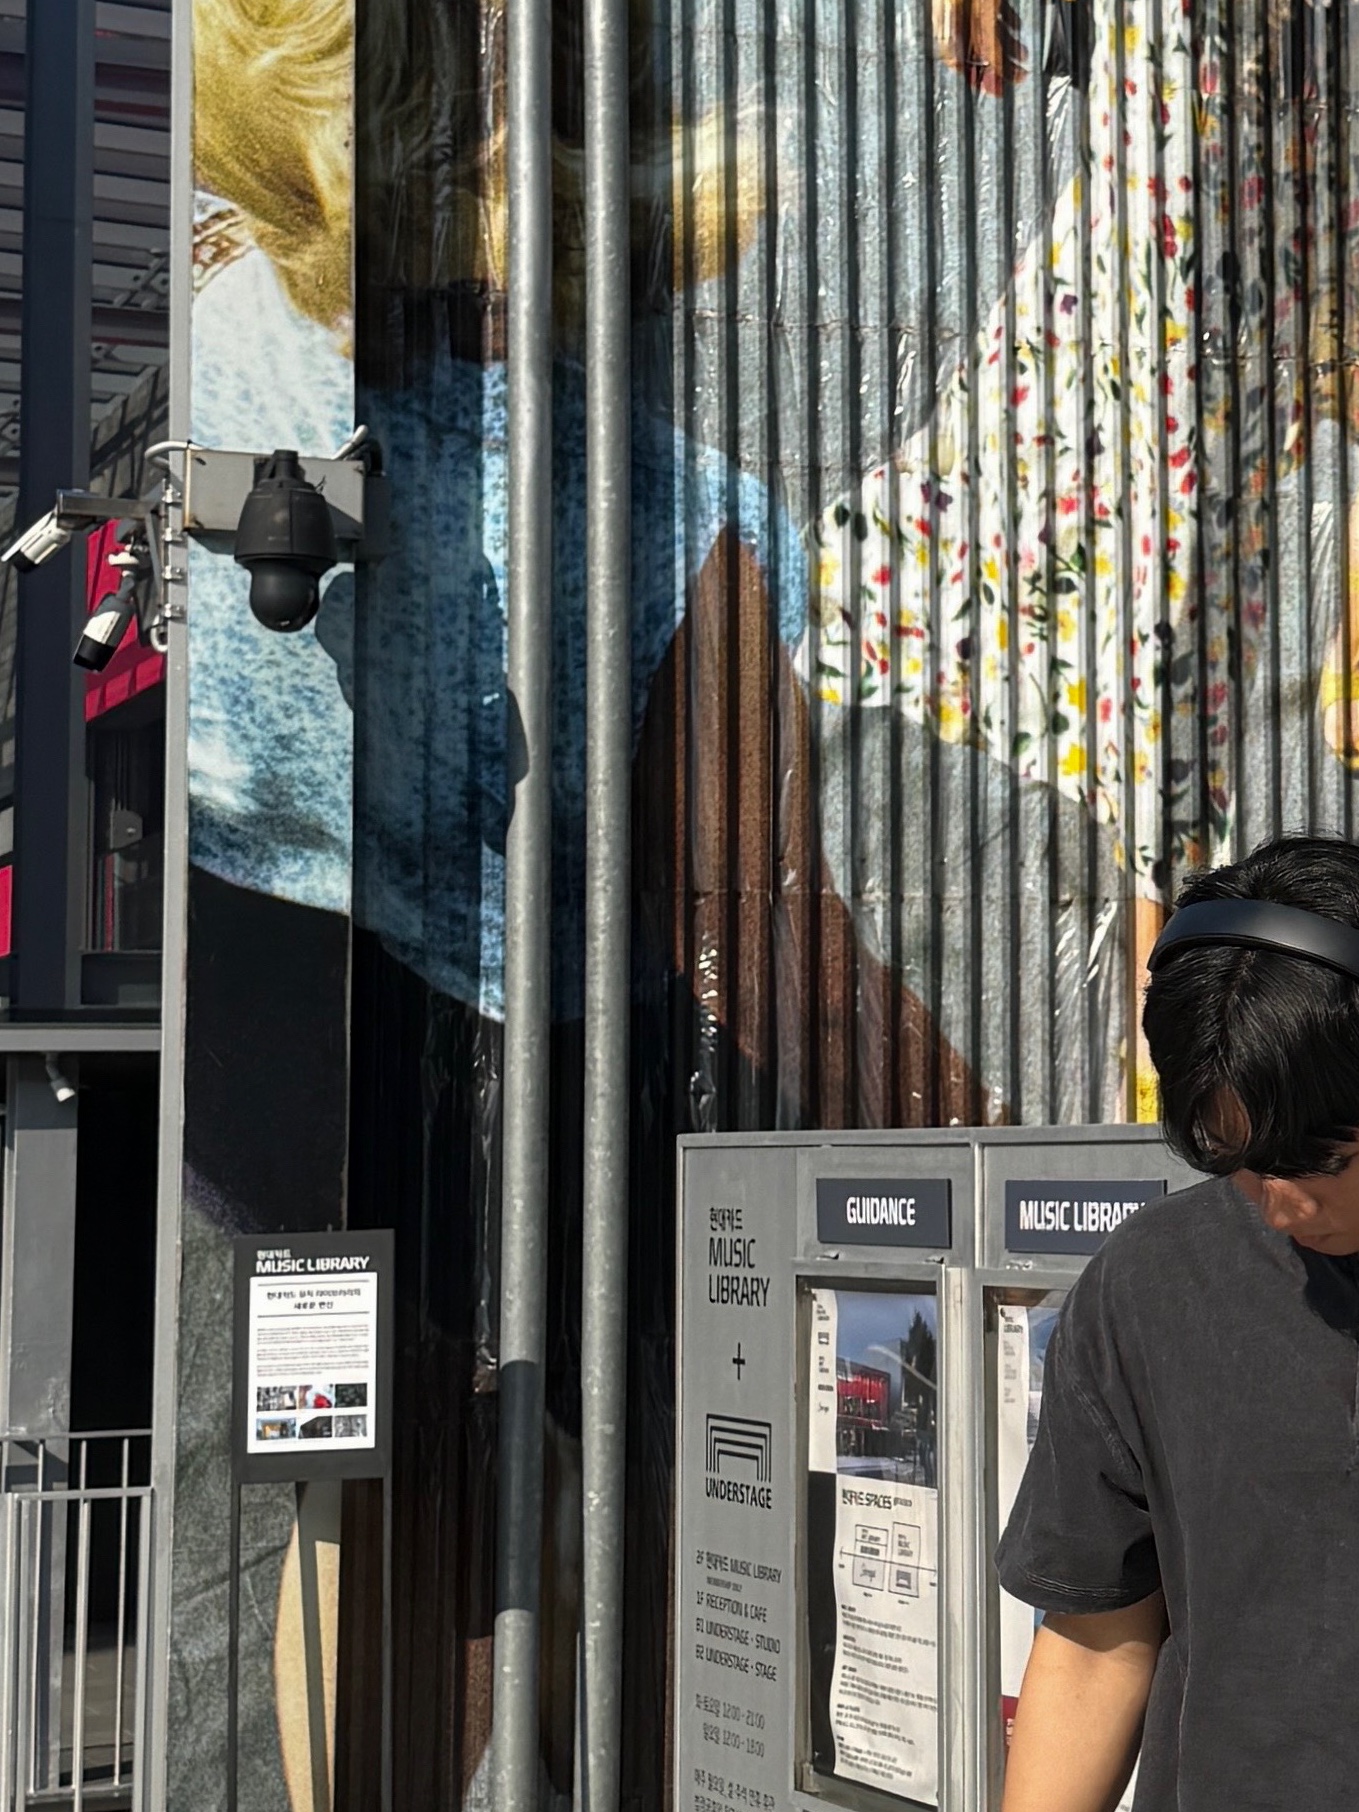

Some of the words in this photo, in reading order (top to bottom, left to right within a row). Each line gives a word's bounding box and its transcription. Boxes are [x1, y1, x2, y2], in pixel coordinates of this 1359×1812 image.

[846, 1196, 916, 1226] GUIDANCE
[1019, 1200, 1071, 1231] MUSIC
[1074, 1201, 1146, 1232] LIBRA
[256, 1258, 304, 1273] MUSIC
[307, 1256, 370, 1271] LIBRARY
[709, 1237, 756, 1268] MUSIC
[709, 1274, 770, 1307] LIBRARY
[705, 1477, 772, 1509] UNDERSTAGE
[706, 1593, 743, 1616] RECEPTION
[750, 1604, 767, 1623] CAFE
[706, 1620, 749, 1646] UNDERSTAGE
[755, 1634, 780, 1654] STUDIO
[706, 1647, 749, 1673] UNDERSTAGE
[755, 1661, 777, 1681] STAGE
